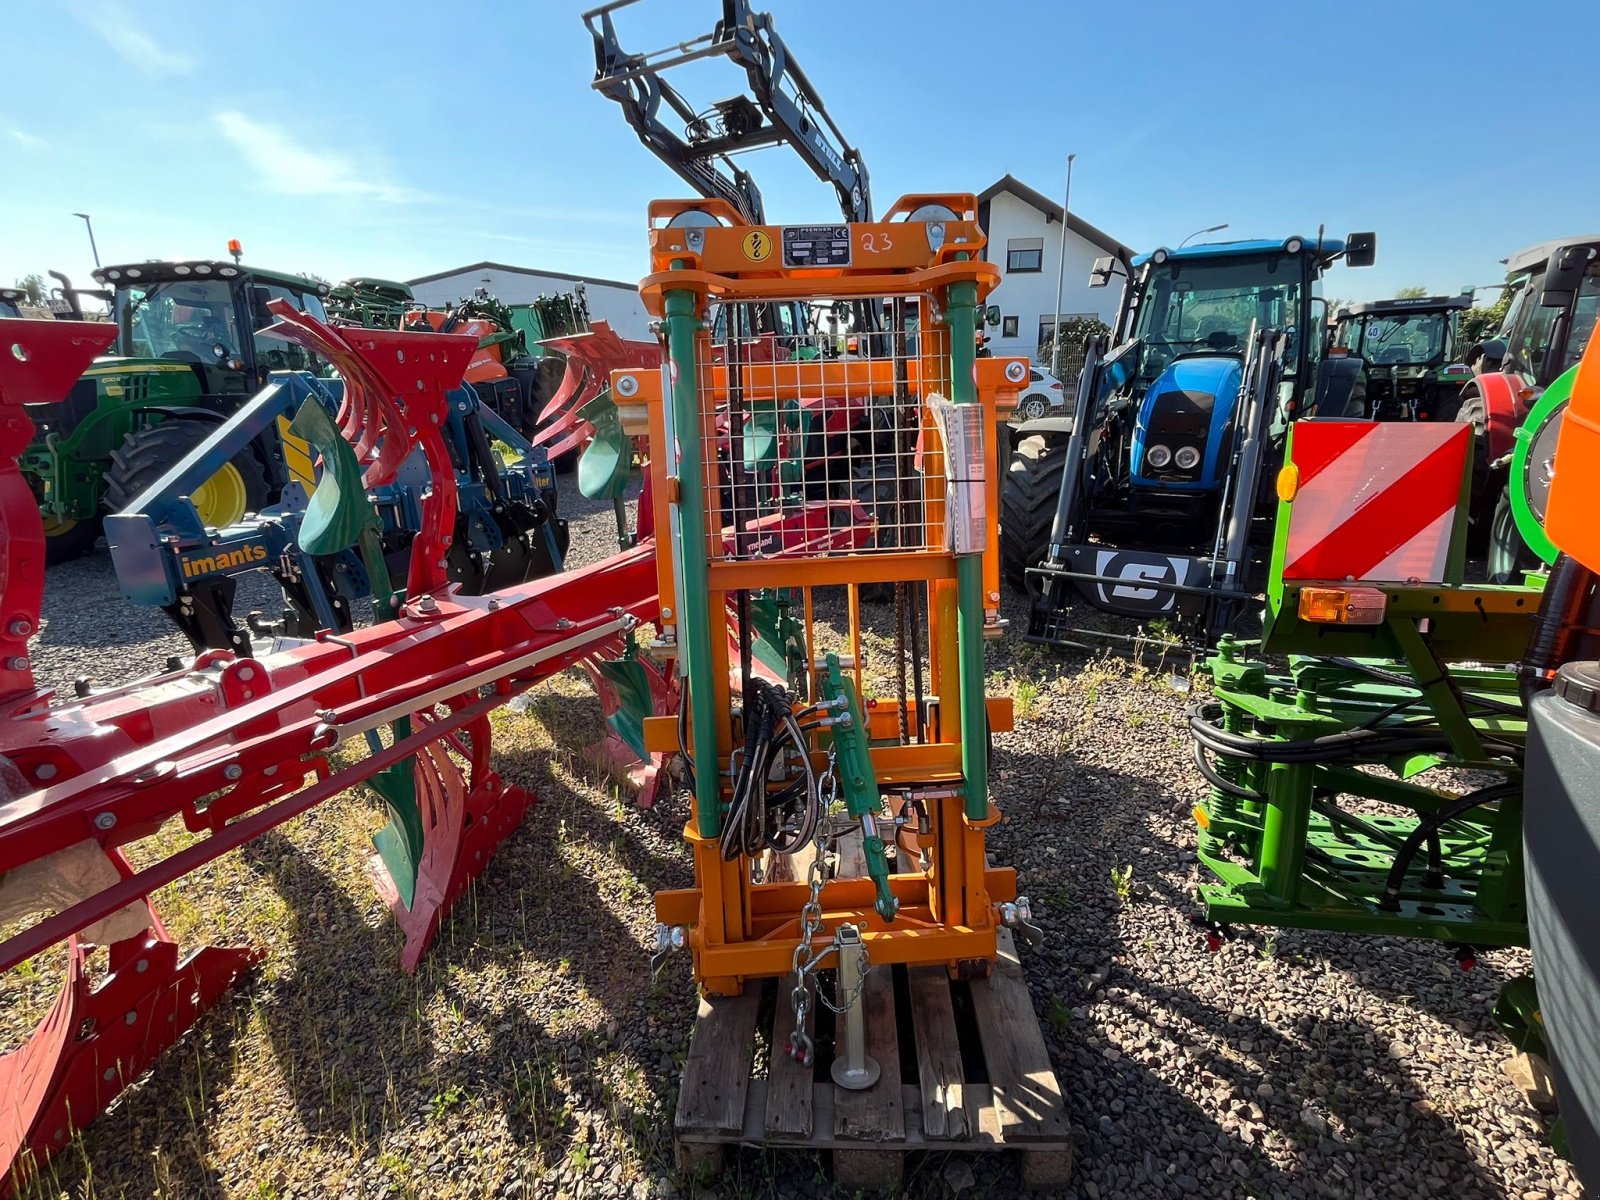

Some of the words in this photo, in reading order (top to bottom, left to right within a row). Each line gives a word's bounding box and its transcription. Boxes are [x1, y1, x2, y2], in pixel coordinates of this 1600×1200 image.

[835, 228, 847, 238] CE
[861, 232, 892, 253] 23
[181, 544, 267, 577] imants
